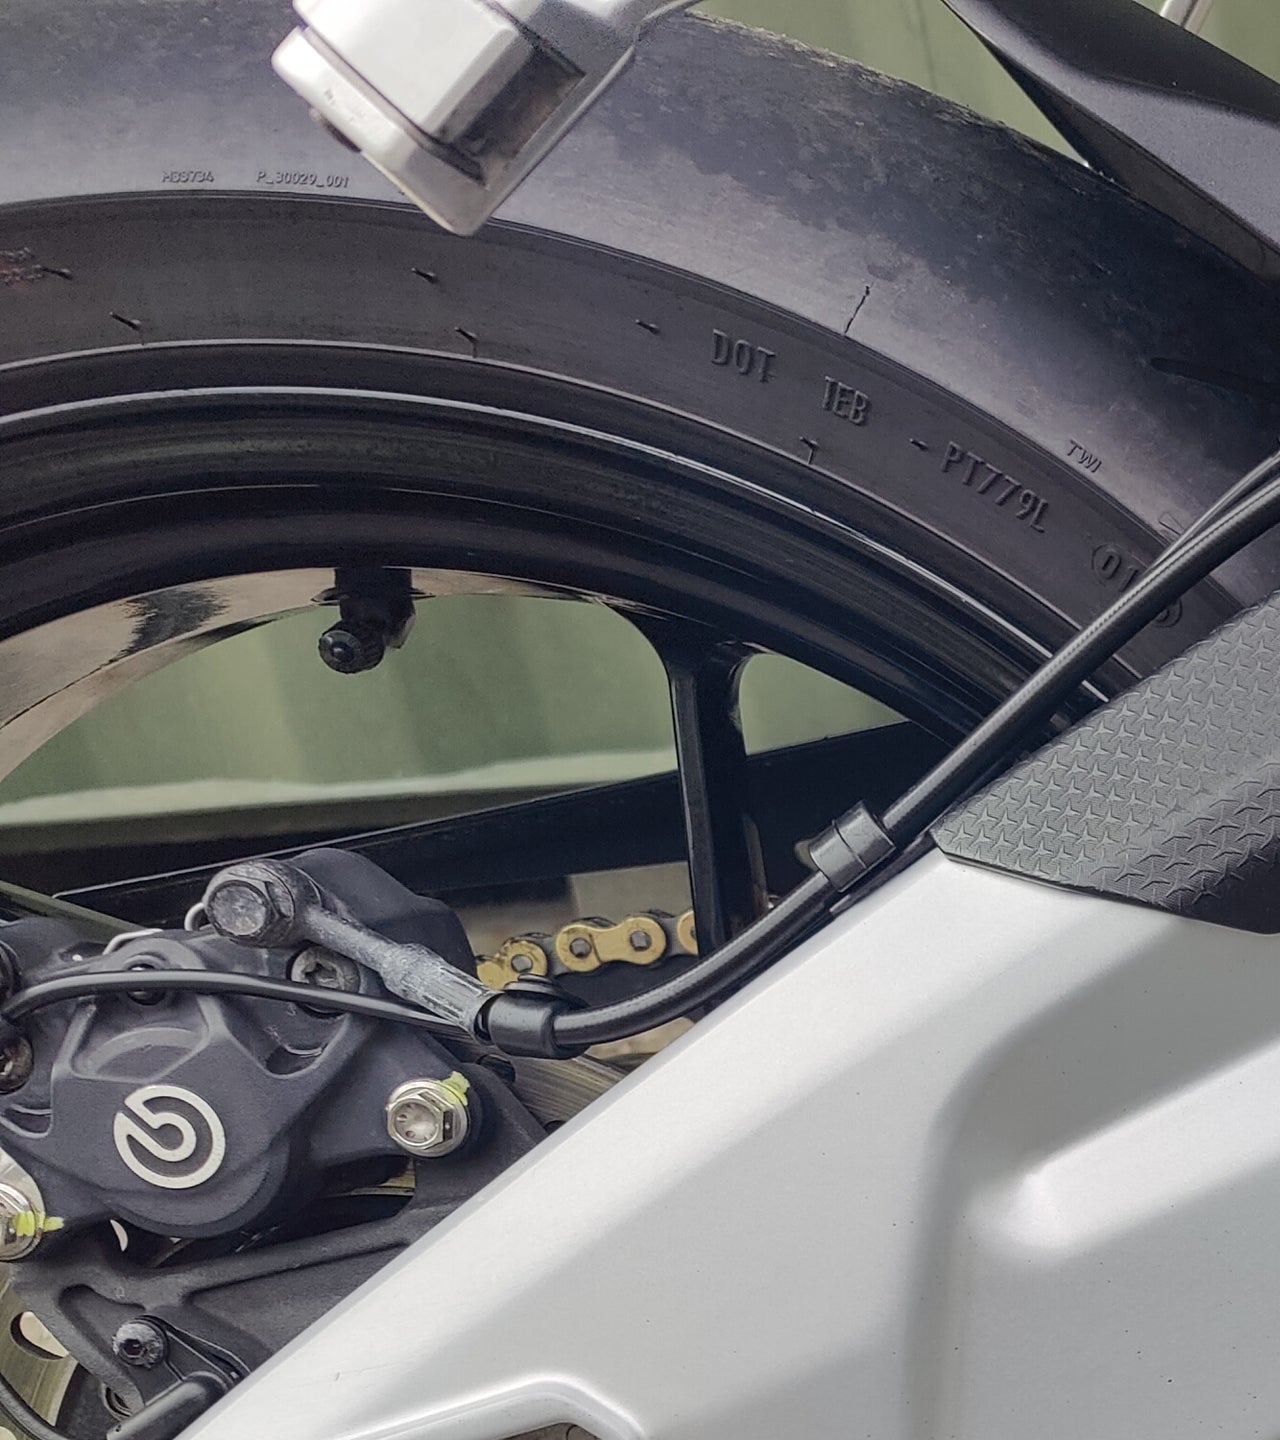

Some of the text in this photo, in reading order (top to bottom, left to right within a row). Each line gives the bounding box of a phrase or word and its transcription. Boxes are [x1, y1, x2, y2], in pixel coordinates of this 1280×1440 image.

[710, 328, 777, 384] DOT
[942, 440, 1052, 534] PT779L
[1066, 438, 1104, 475] TWI
